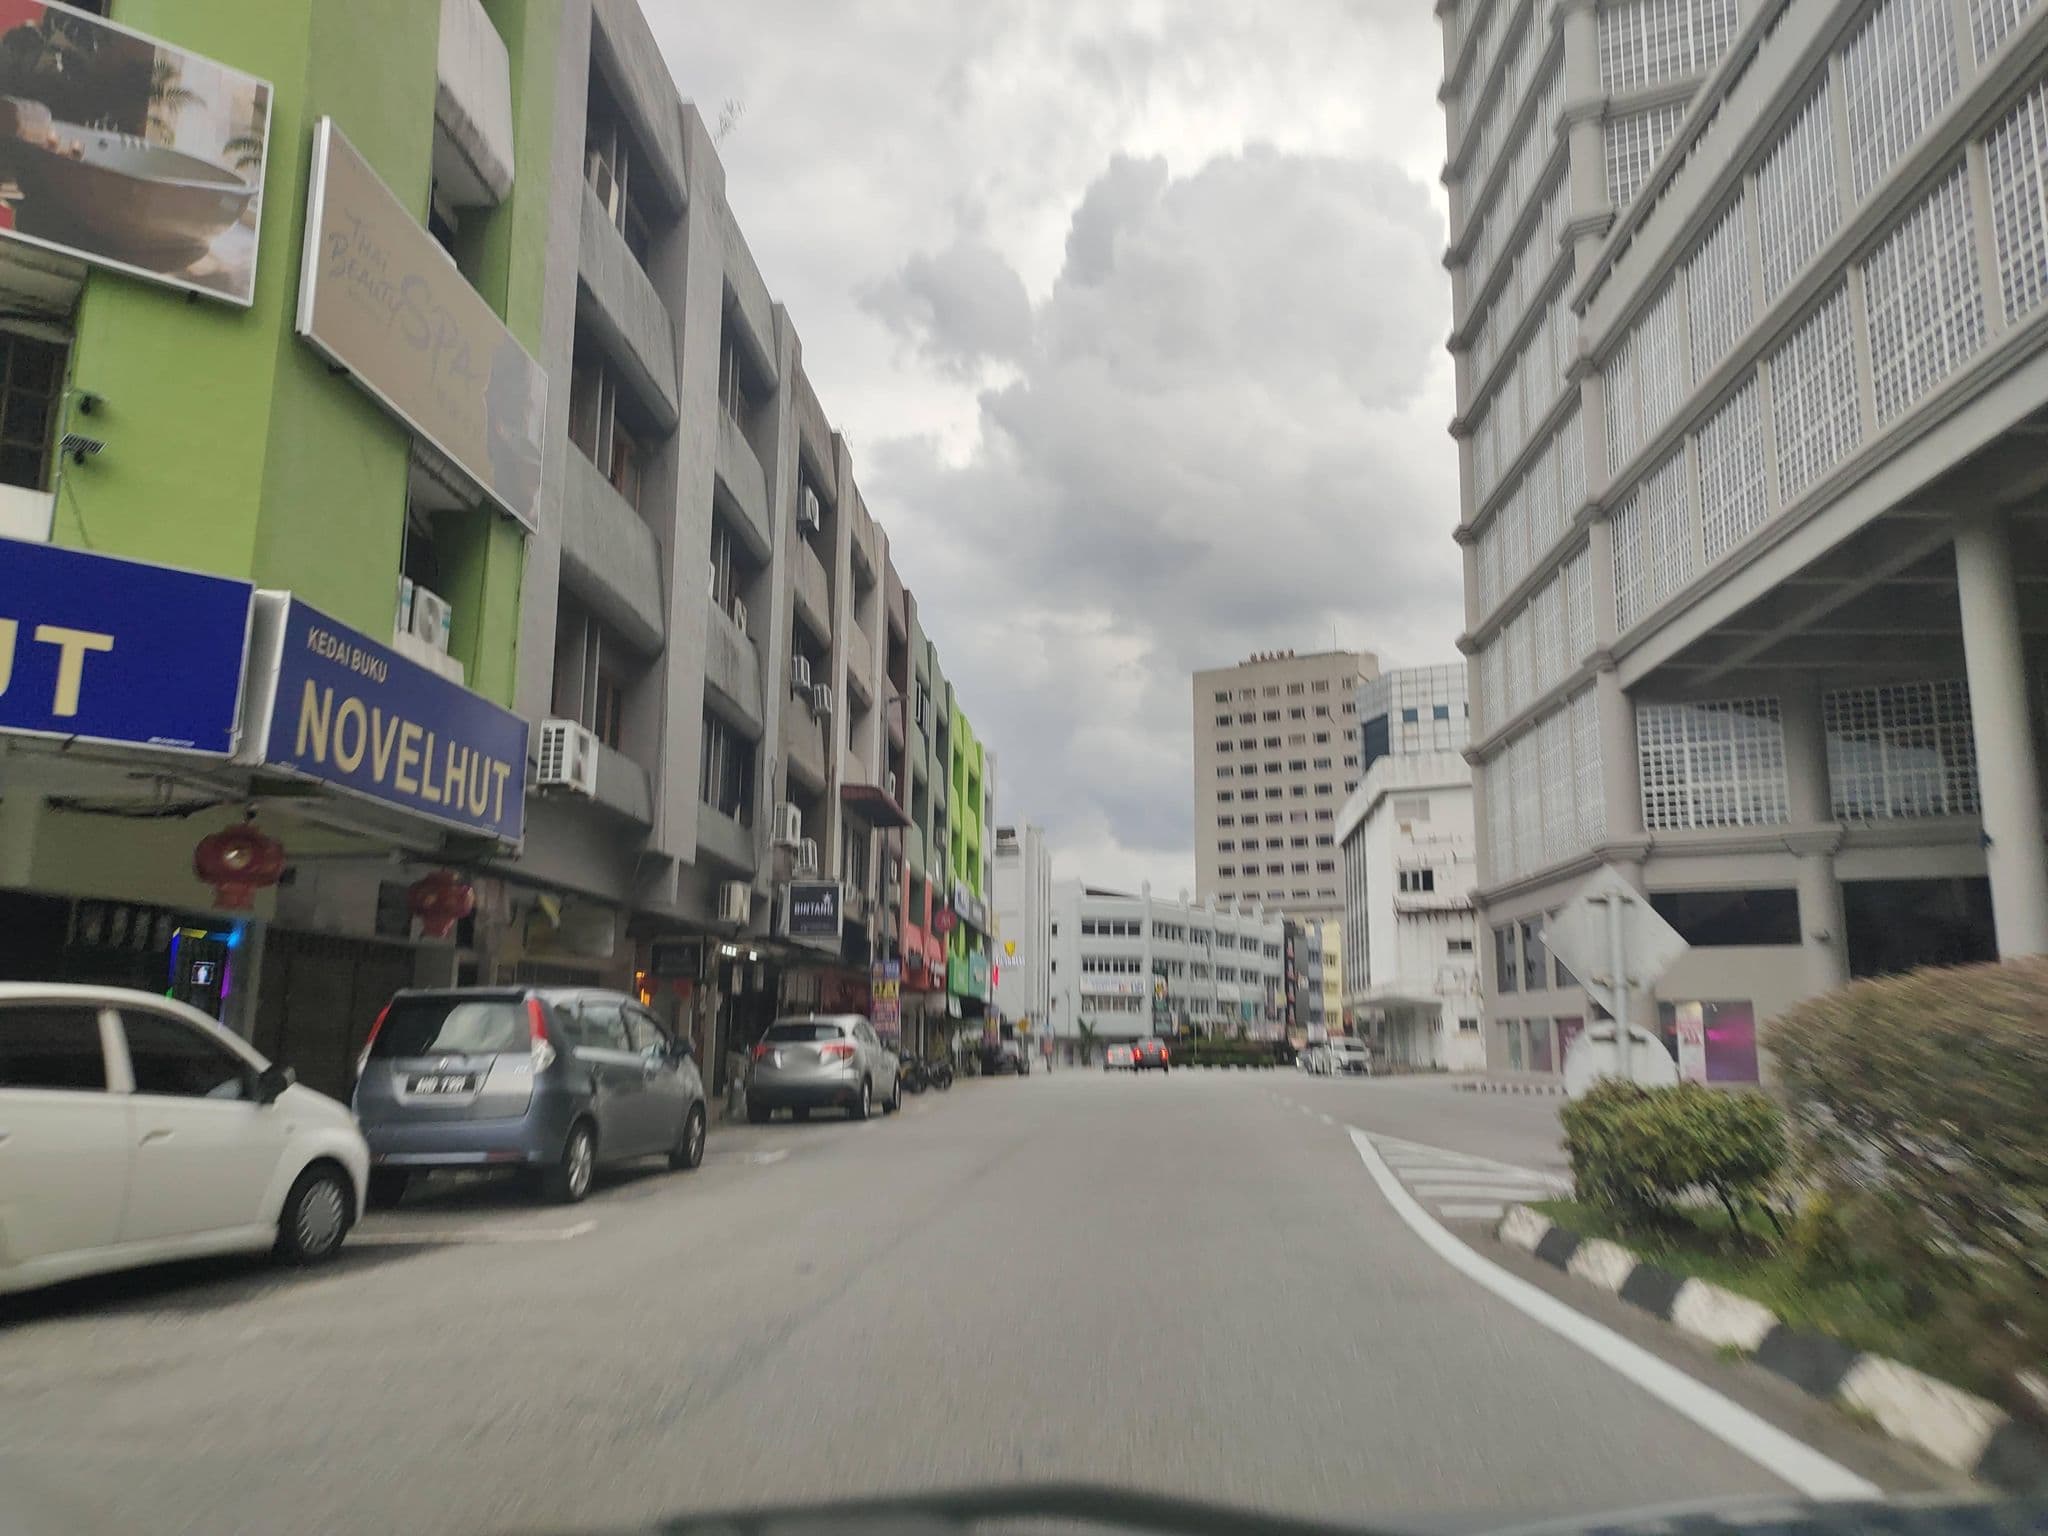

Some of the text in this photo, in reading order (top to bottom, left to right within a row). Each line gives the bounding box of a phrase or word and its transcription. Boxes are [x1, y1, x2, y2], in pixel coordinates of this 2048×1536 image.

[306, 625, 388, 684] KEDAI BUKU
[295, 678, 511, 823] NOVELHUT
